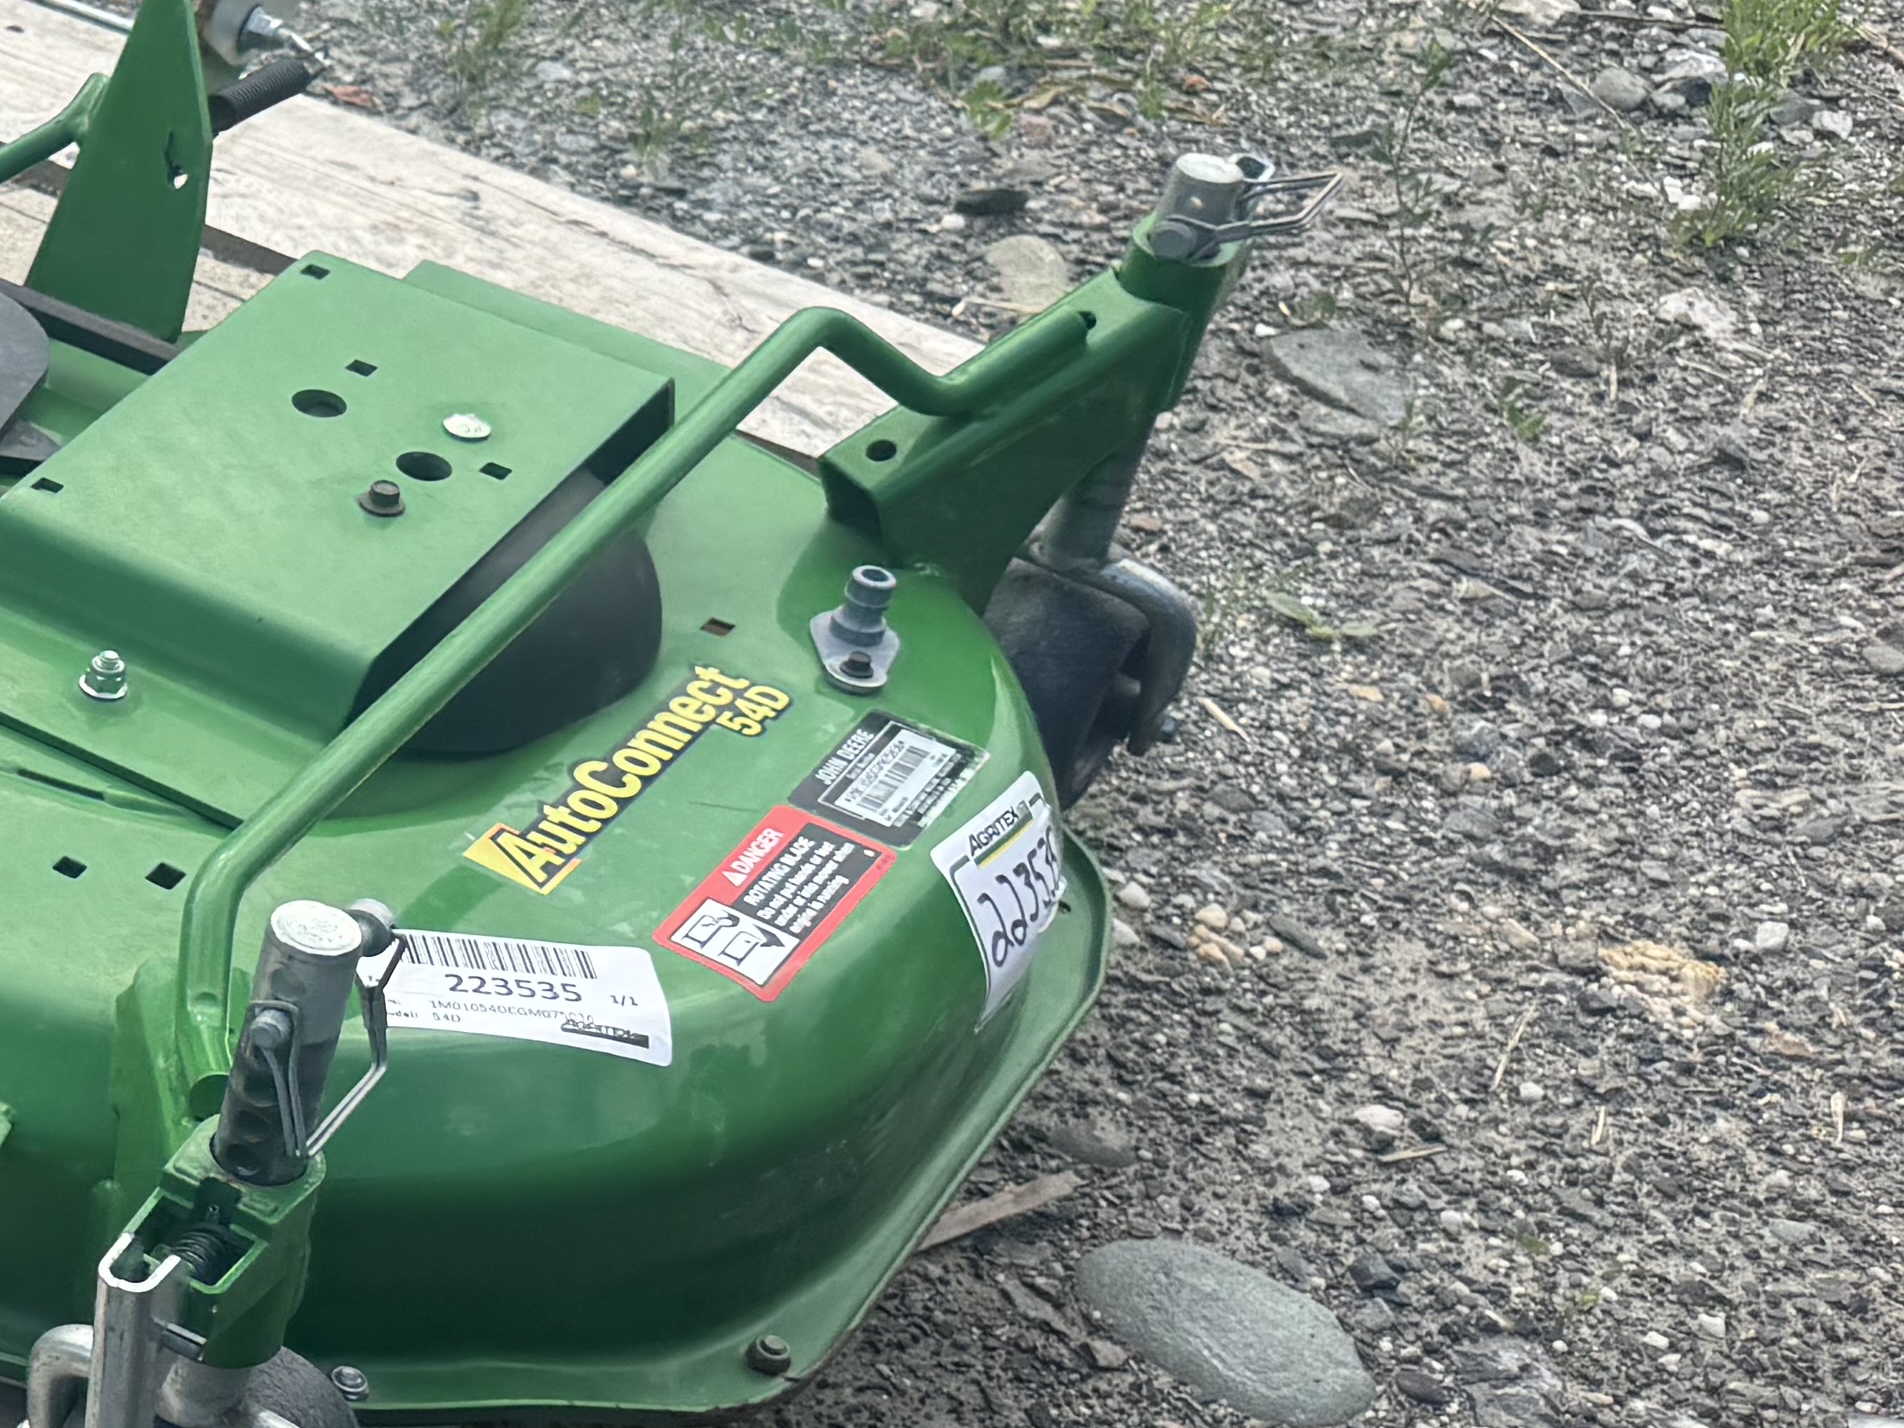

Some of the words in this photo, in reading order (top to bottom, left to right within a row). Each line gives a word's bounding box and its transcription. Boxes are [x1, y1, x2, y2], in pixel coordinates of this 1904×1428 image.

[716, 685, 789, 736] 54D
[496, 666, 750, 882] AutoConnect
[815, 758, 847, 785] JOHN
[837, 729, 874, 760] DEERE
[731, 828, 784, 875] DANGER
[968, 806, 1019, 857] AGRITEX
[744, 863, 790, 906] ROTATING
[780, 836, 816, 866] BLADE
[445, 973, 582, 1002] 223535
[610, 994, 638, 1007] 1/1
